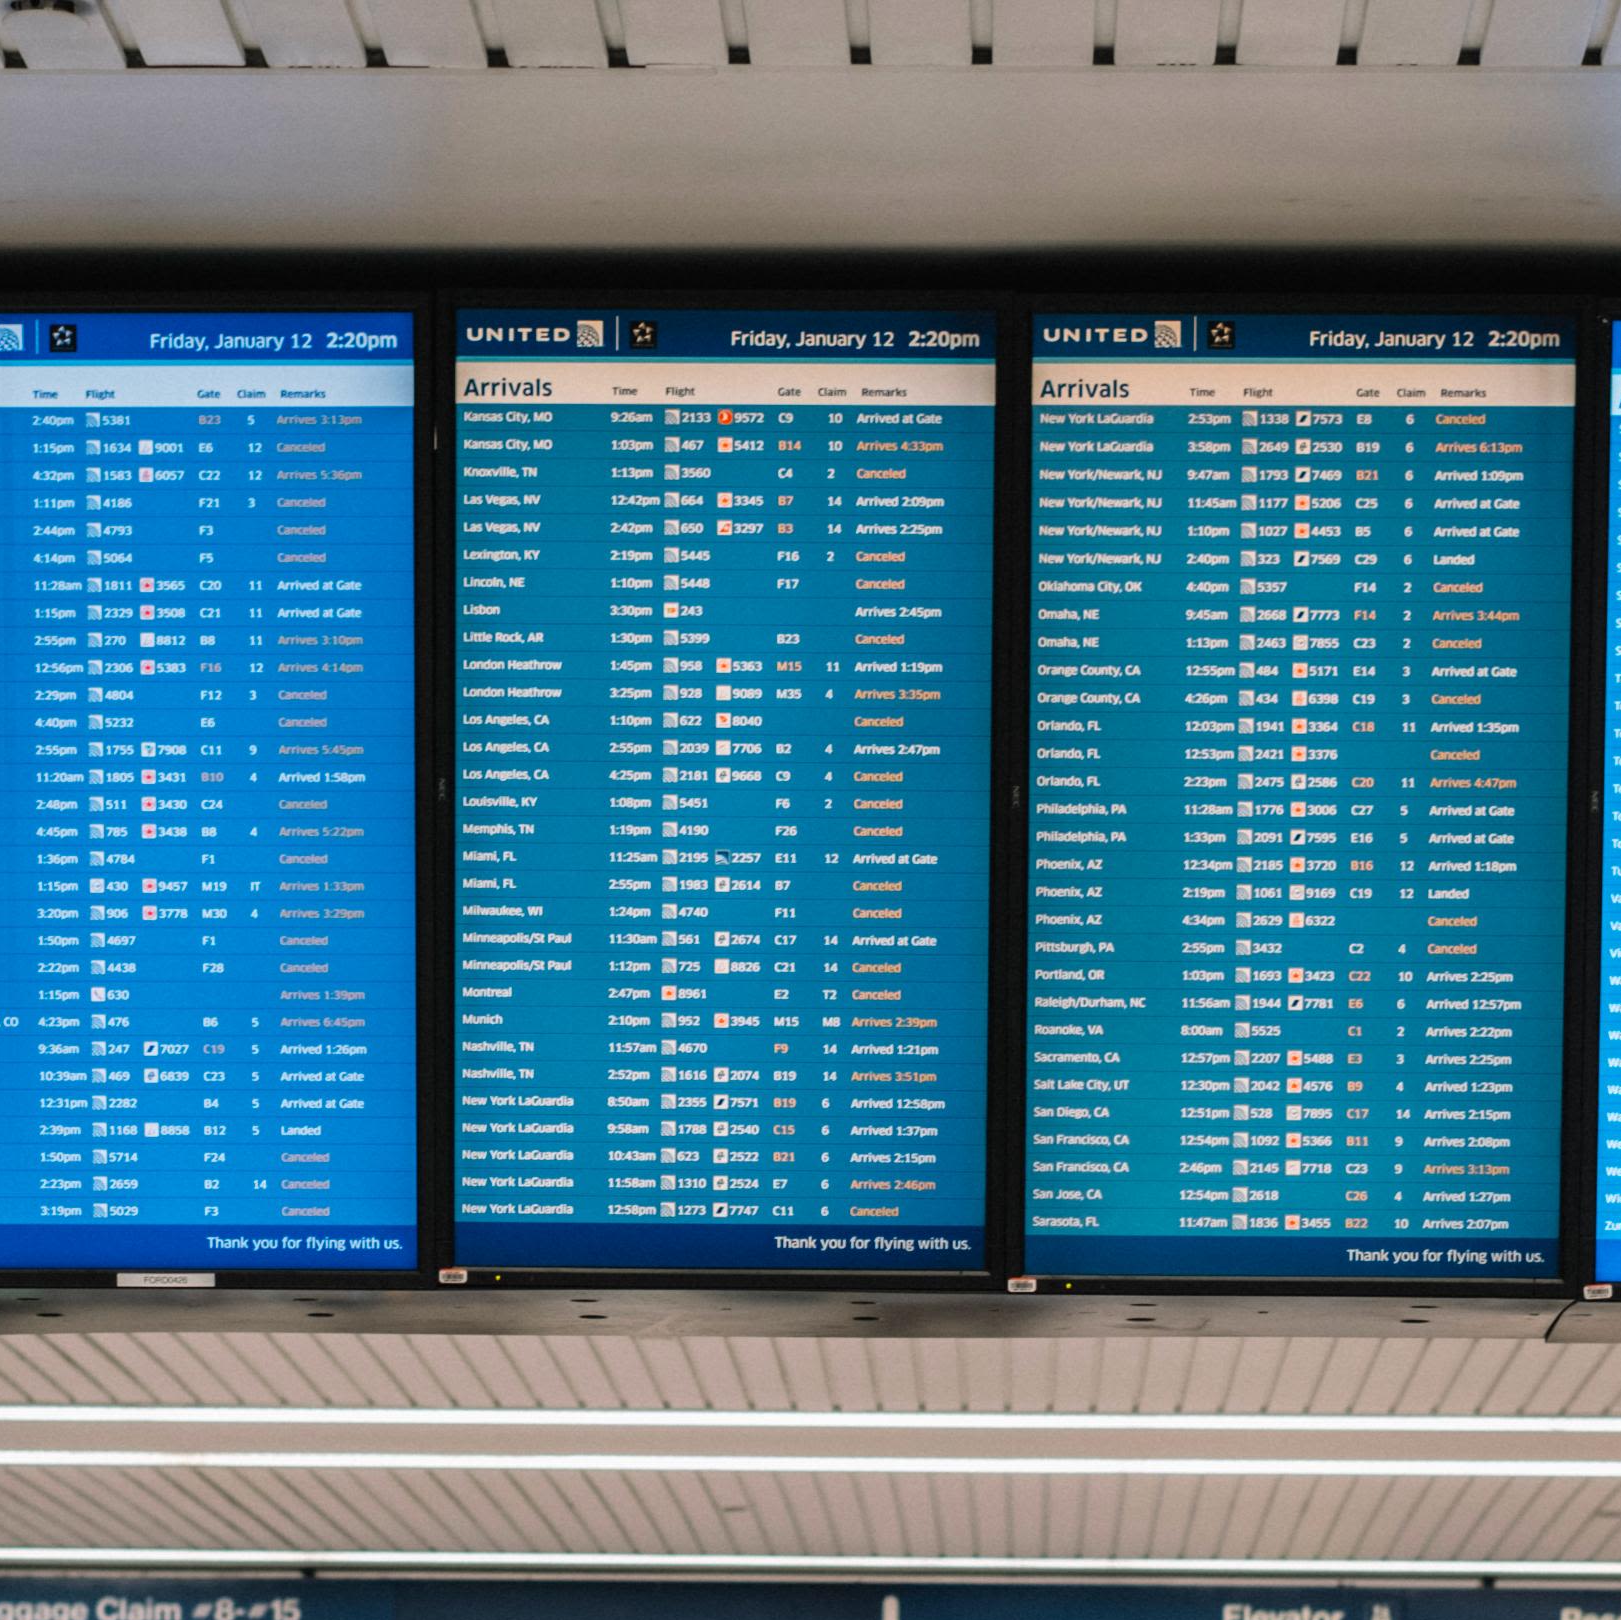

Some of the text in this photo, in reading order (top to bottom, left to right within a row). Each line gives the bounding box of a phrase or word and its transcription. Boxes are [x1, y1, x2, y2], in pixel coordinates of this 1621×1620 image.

[151, 332, 397, 351] Friday, January 12 2:20pm
[467, 328, 570, 342] UNITED
[731, 330, 979, 350] Friday, January 12 2:20pm
[1044, 328, 1148, 342] UNITED
[1310, 330, 1559, 349] Friday, January 12 2:20pm
[464, 378, 907, 397] Arrivals Time Flight Gate Claim Remarks
[1040, 379, 1129, 398] Arrivals
[1036, 885, 1469, 899] Phoenix, AZ 2:19pm 1061 9169 C19 12 Landed
[37, 908, 79, 919] 3:20pm
[106, 908, 128, 918] 906
[159, 909, 188, 918] 3778
[202, 909, 227, 918] M30
[251, 909, 258, 918] 4
[280, 909, 320, 918] Arrives
